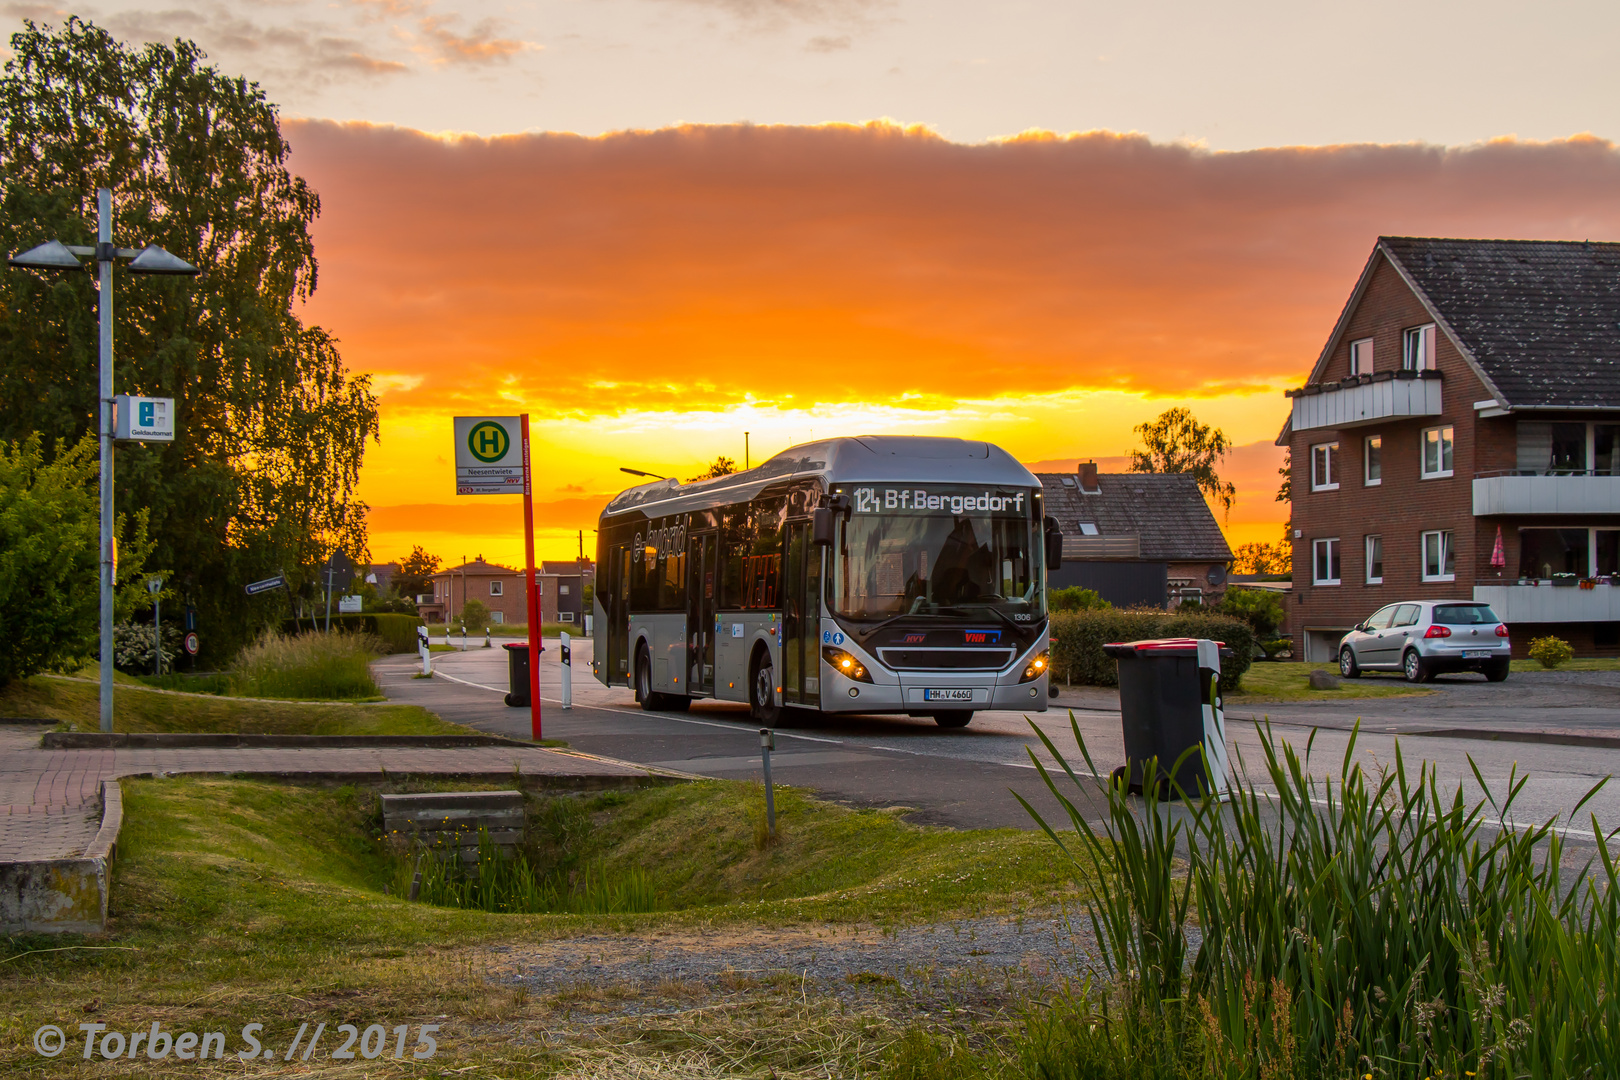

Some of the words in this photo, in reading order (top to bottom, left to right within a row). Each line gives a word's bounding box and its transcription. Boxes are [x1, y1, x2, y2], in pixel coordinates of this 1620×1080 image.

[131, 429, 173, 437] Geldautomat
[480, 430, 499, 453] H
[853, 487, 881, 513] 124
[633, 513, 688, 569] e-hybrid
[1014, 613, 1031, 621] 1306
[906, 635, 926, 643] HVV
[965, 634, 986, 642] VHH
[951, 690, 971, 699] 4660
